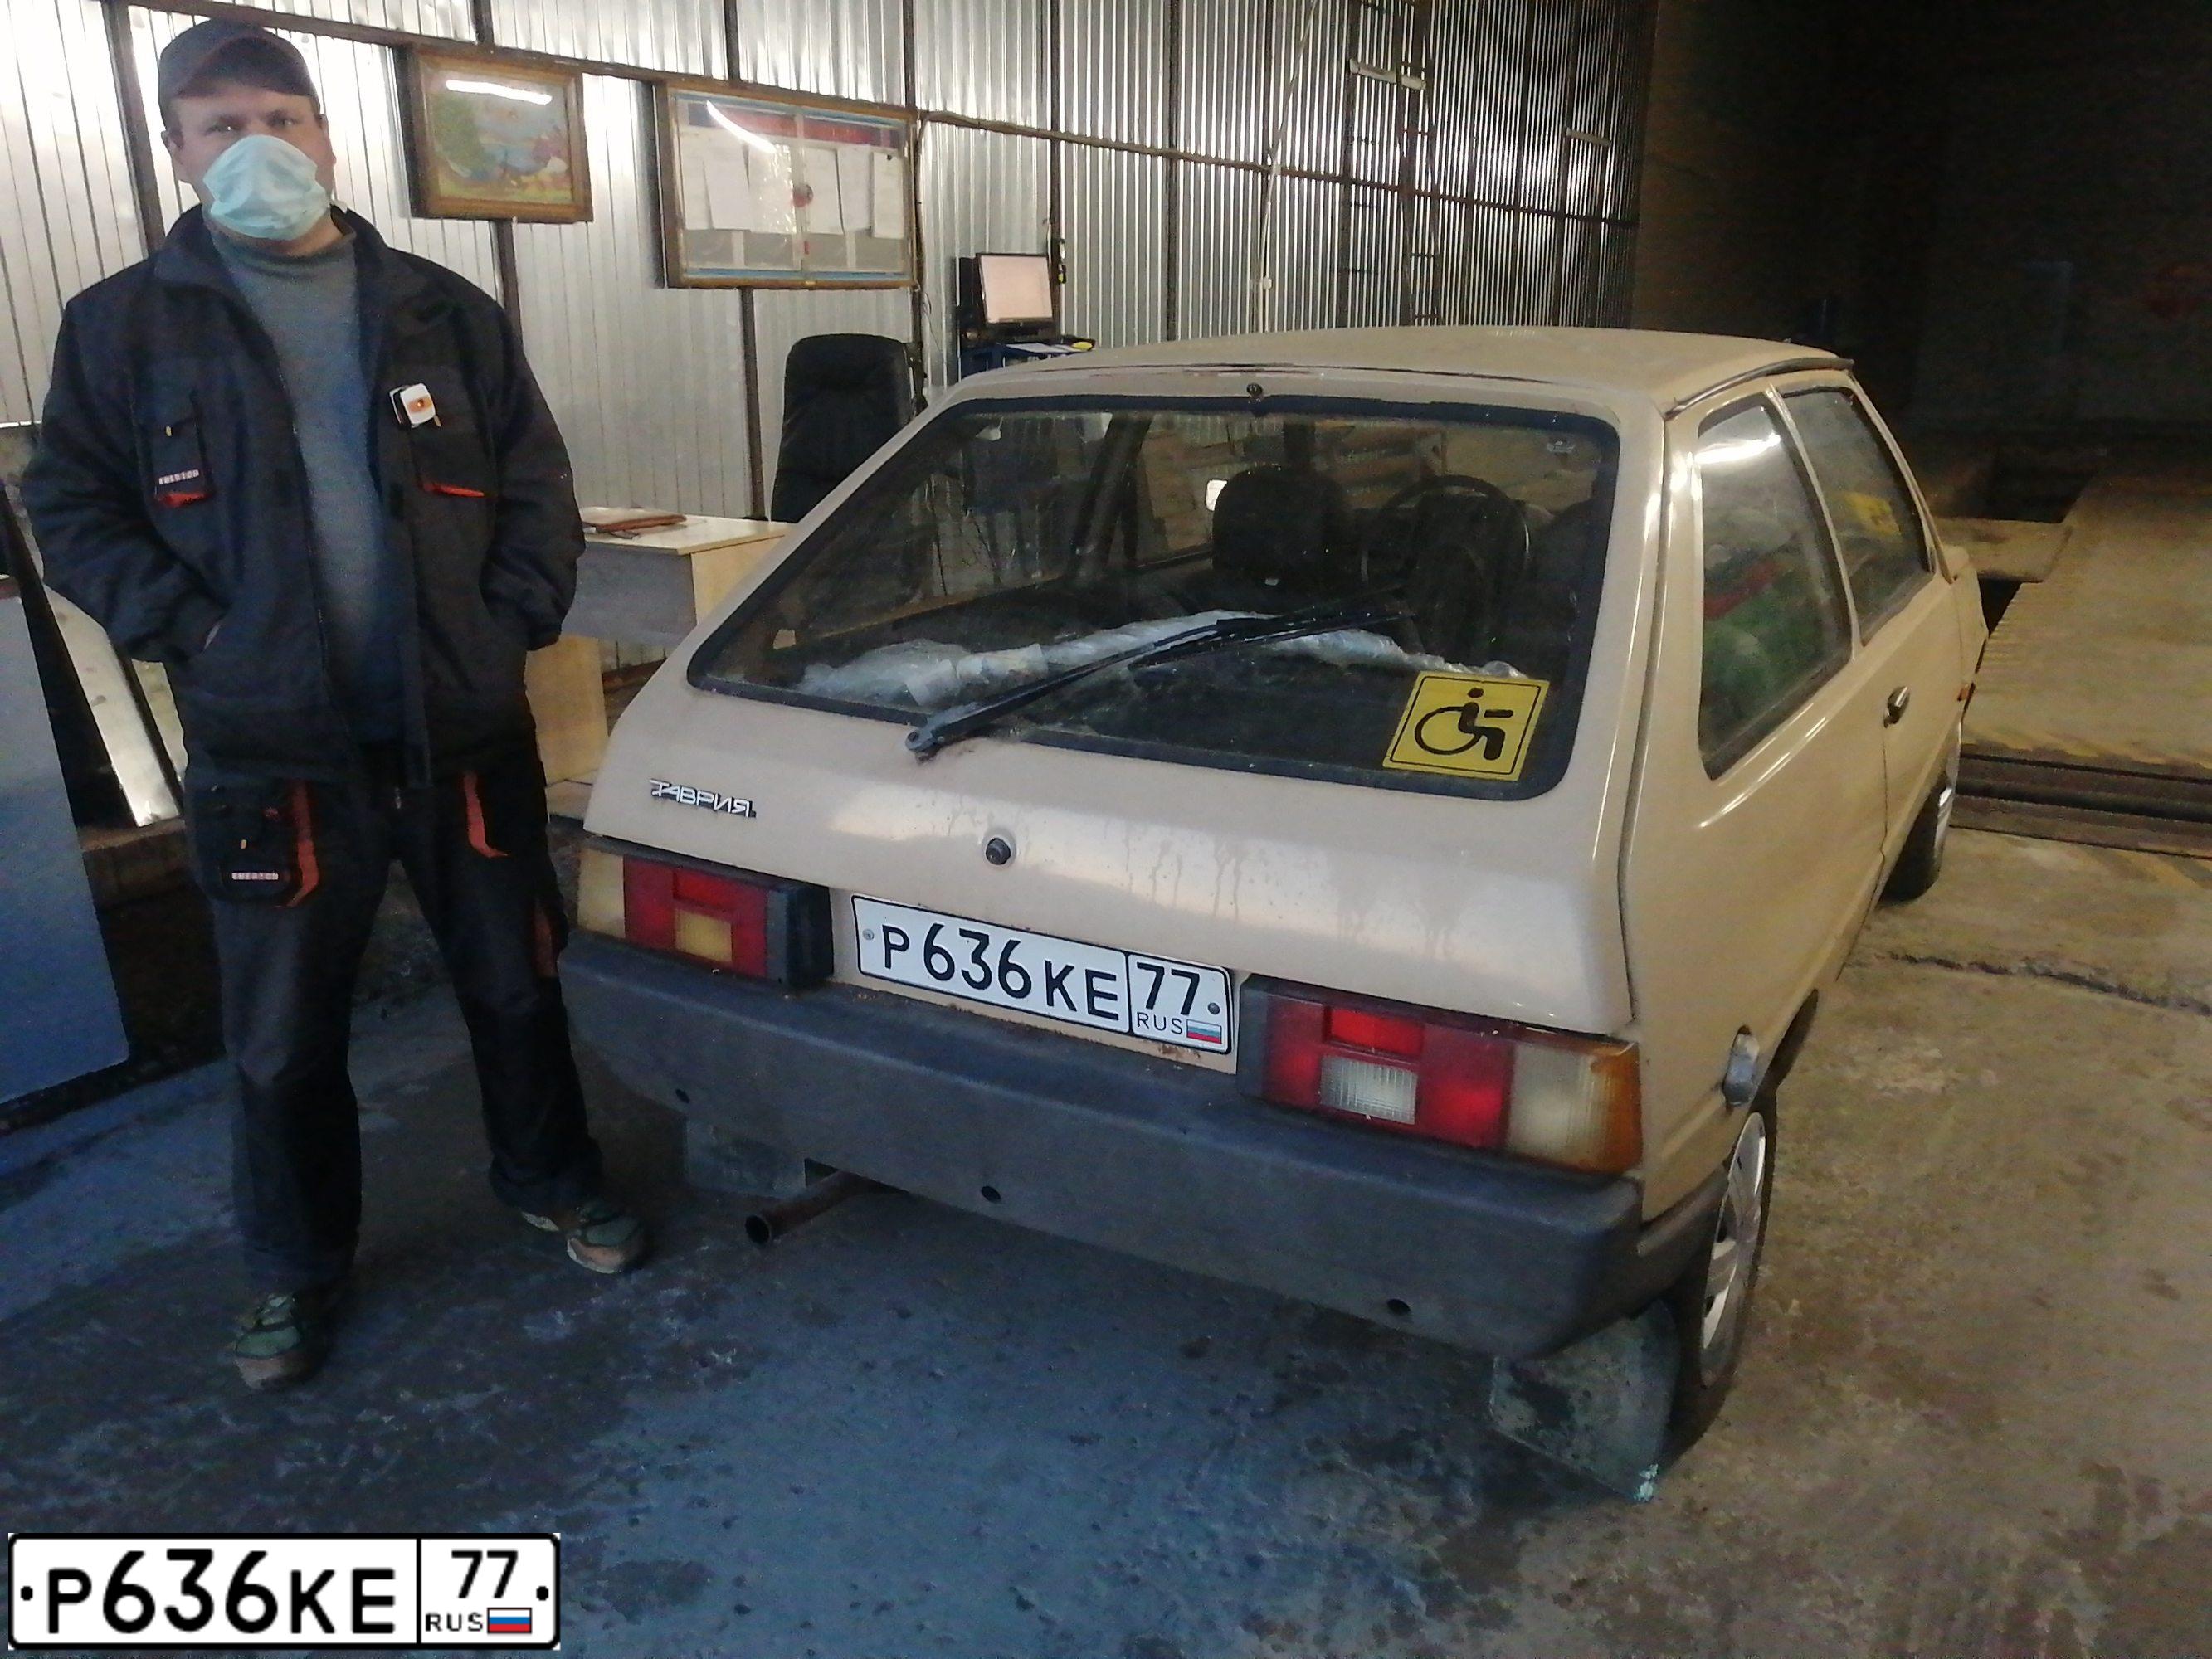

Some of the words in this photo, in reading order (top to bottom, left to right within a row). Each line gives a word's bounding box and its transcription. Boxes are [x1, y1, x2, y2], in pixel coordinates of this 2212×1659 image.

[649, 778, 752, 817] ТАВРИЯ
[1136, 961, 1201, 1016] 77
[1136, 1011, 1183, 1035] RUS
